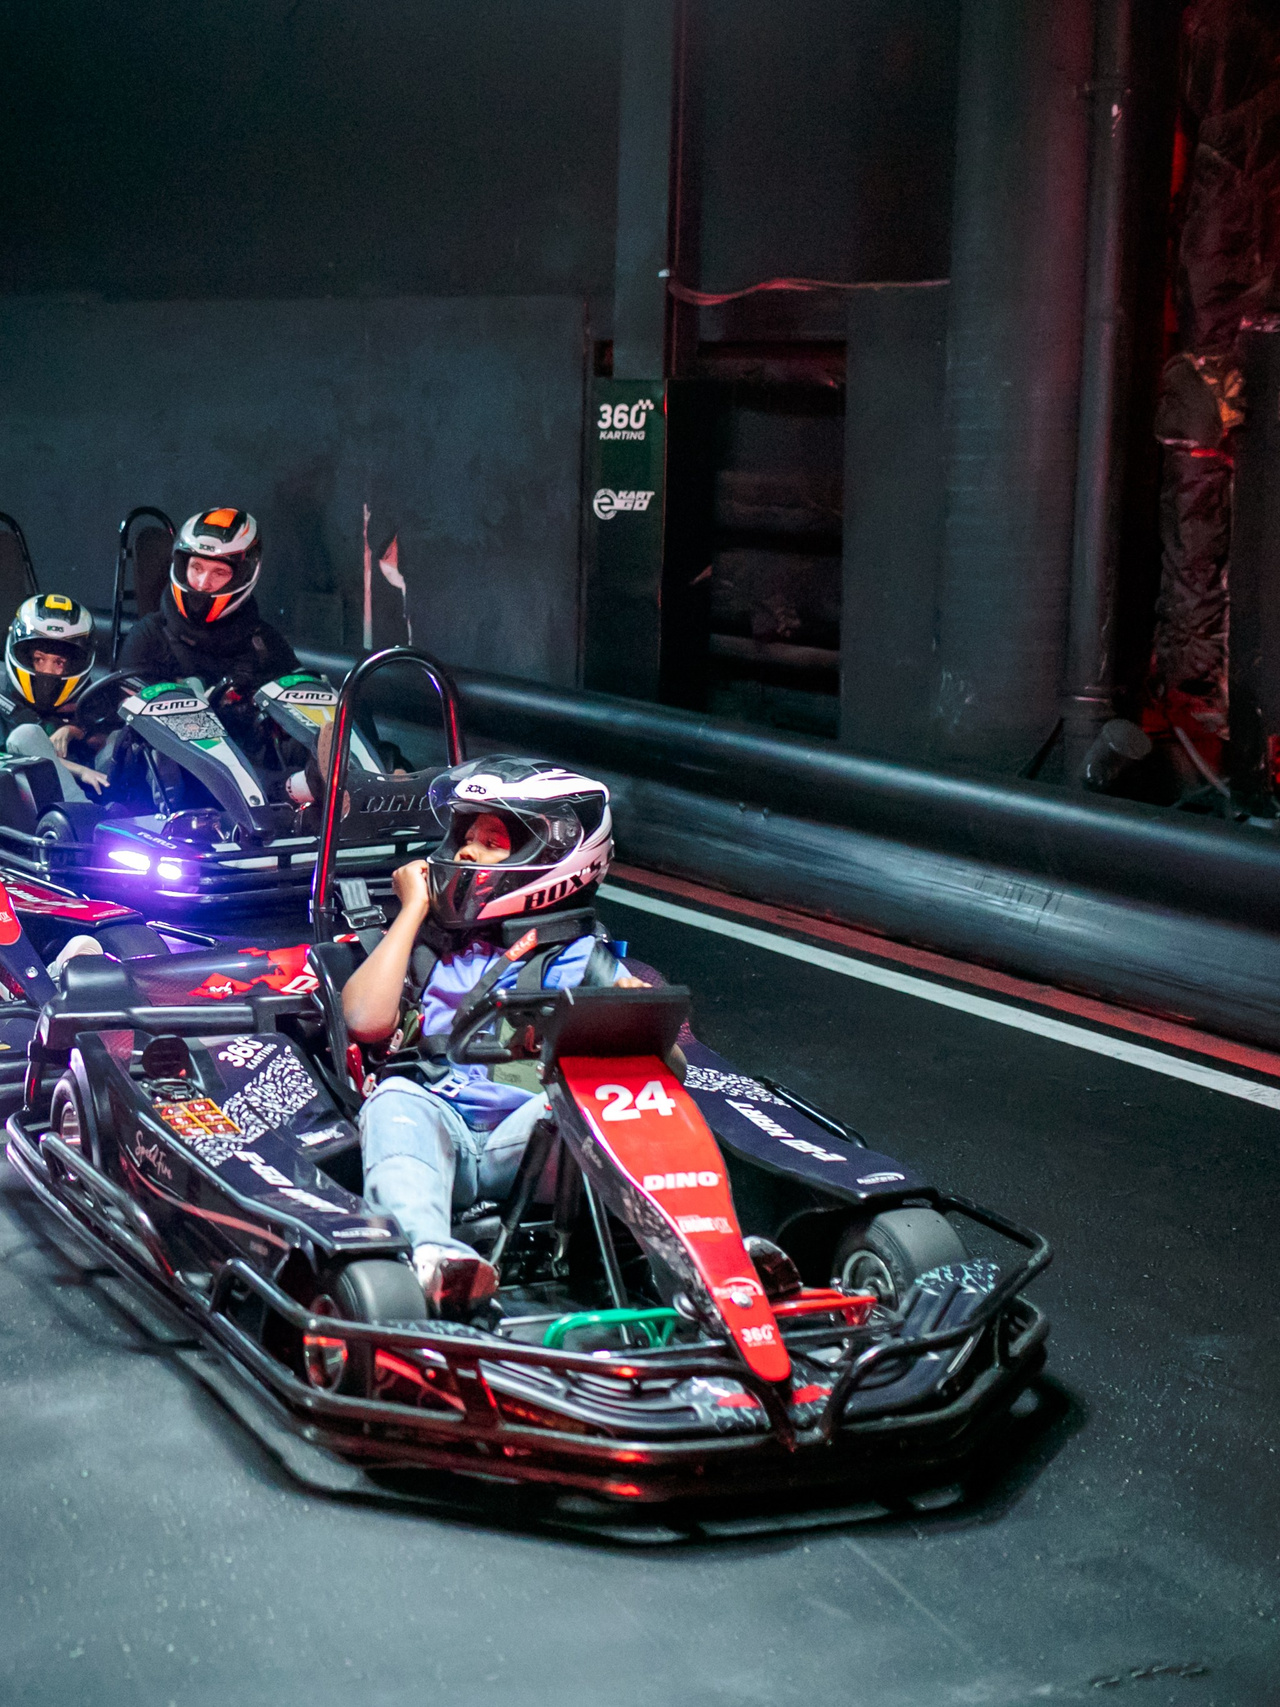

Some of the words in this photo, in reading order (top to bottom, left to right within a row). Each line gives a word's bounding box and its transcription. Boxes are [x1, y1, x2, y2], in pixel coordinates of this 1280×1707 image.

[597, 401, 650, 429] 360
[599, 431, 645, 440] KARTING
[617, 491, 655, 500] KART
[218, 1036, 265, 1067] 360
[245, 1043, 278, 1071] KARTING
[594, 1080, 676, 1121] 24
[643, 1171, 720, 1191] DINO
